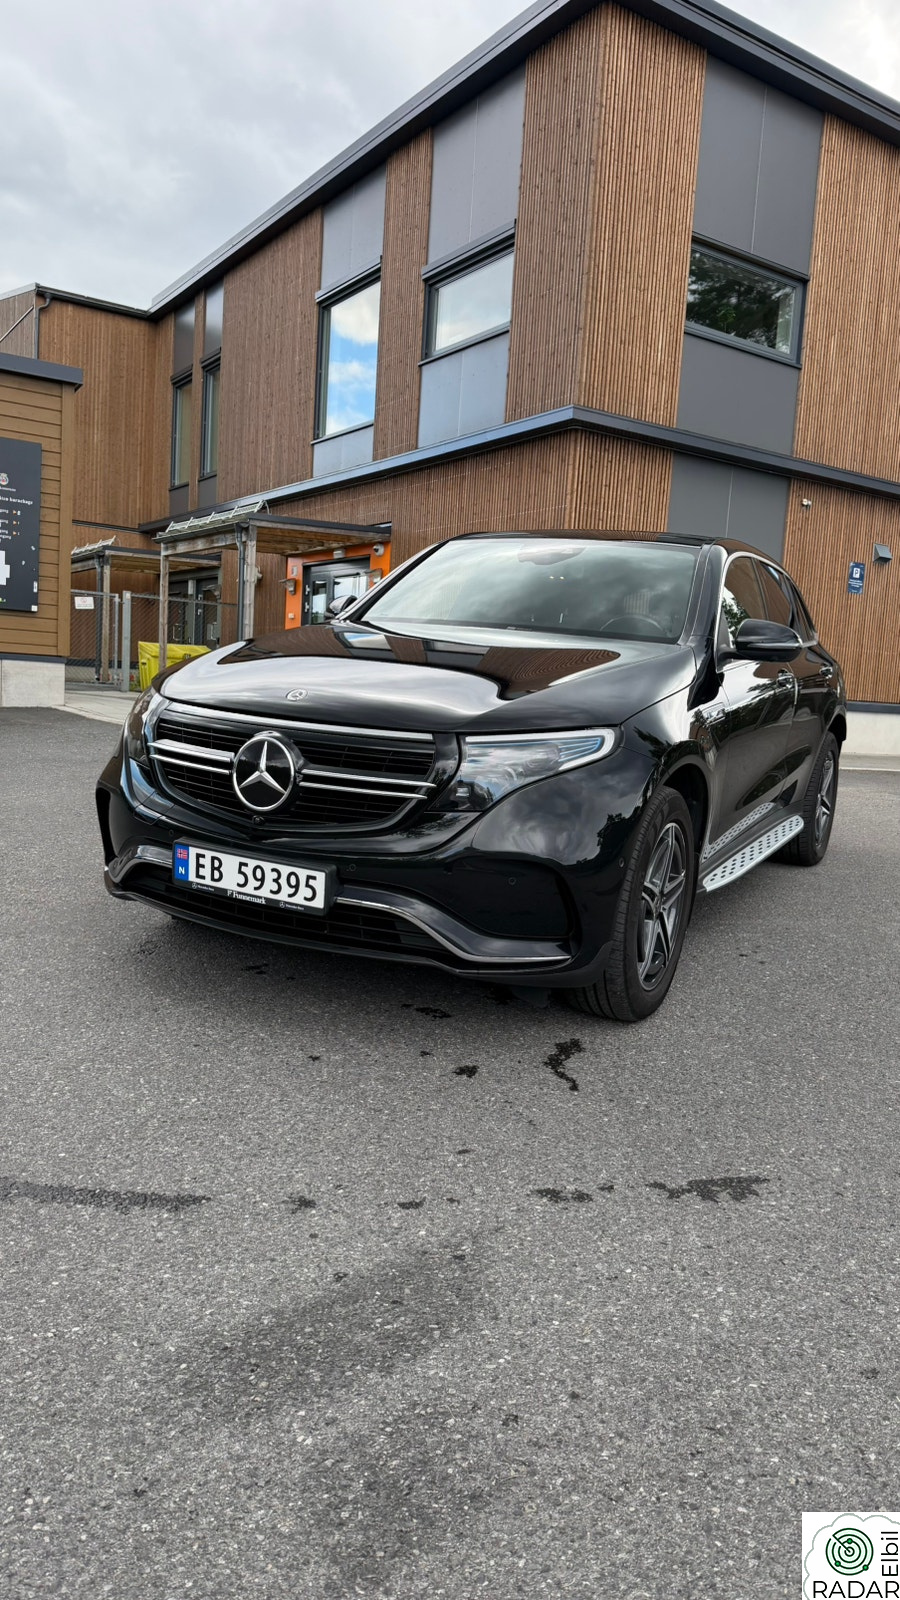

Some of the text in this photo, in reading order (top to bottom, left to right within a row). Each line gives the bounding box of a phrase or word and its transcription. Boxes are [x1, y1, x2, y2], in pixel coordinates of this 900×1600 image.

[178, 866, 185, 875] N
[195, 852, 317, 902] EB 59395
